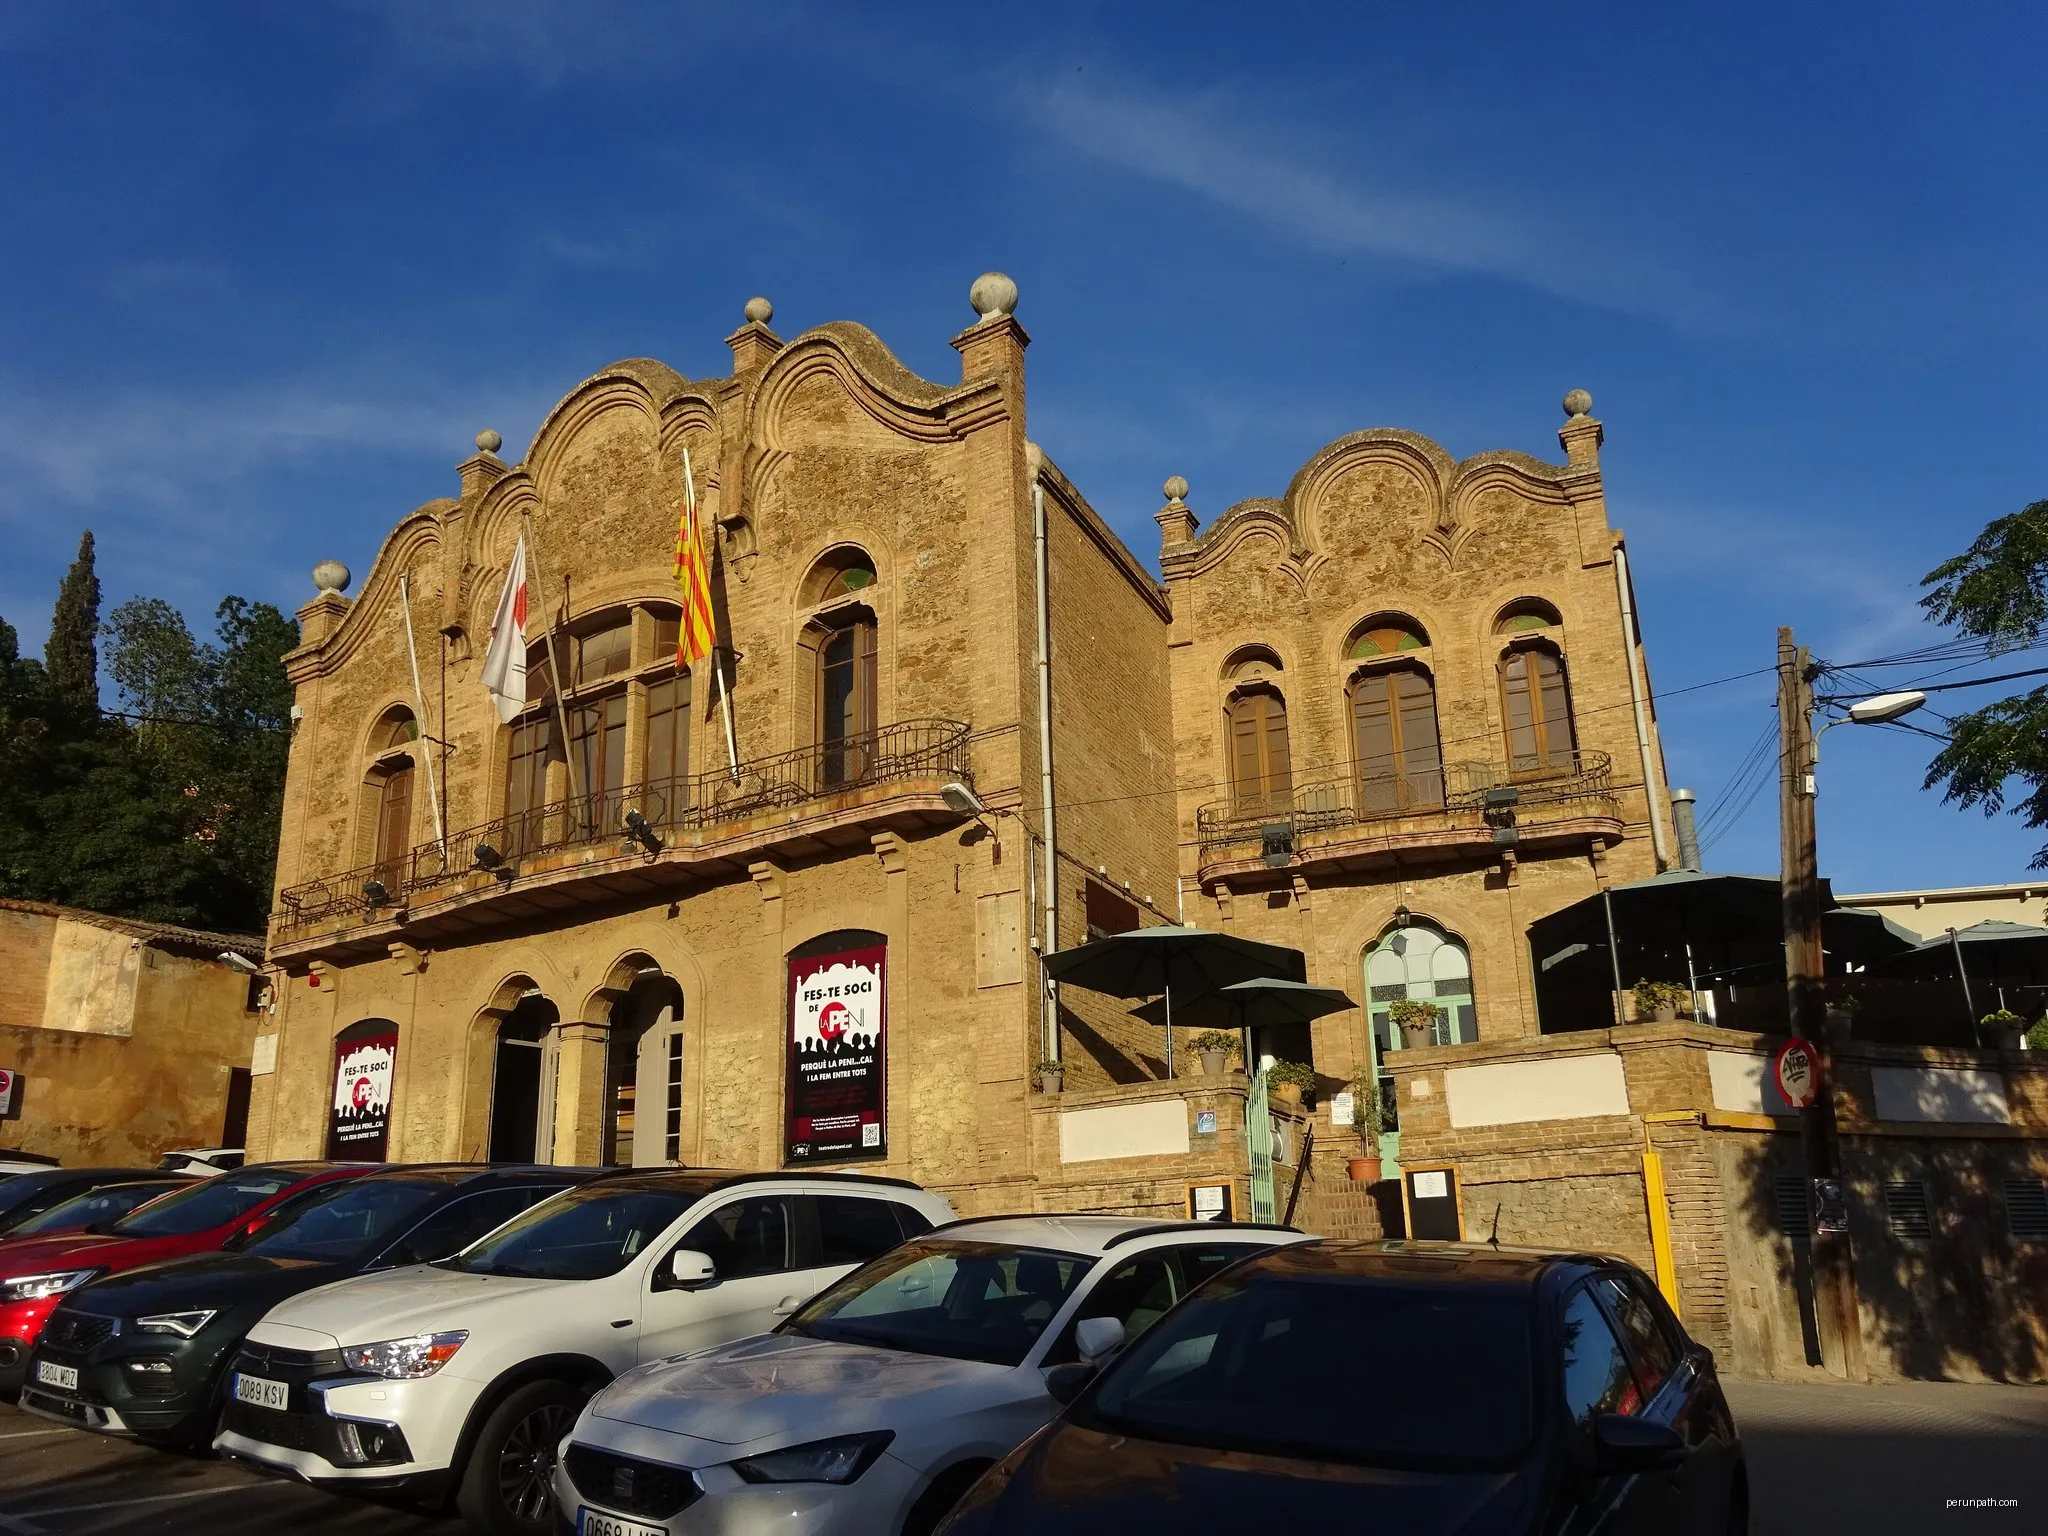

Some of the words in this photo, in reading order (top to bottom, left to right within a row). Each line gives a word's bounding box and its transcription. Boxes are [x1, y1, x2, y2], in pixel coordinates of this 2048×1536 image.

[804, 986, 840, 1001] FES-TE
[844, 981, 872, 996] SOCI
[808, 1004, 819, 1013] DE
[345, 1065, 368, 1076] FES-TE
[370, 1061, 388, 1071] SOCI
[800, 1059, 827, 1071] PERQUÈ
[828, 1060, 837, 1068] LA
[810, 1074, 818, 1082] LA
[820, 1072, 832, 1080] FEM
[832, 1070, 851, 1079] ENTRE
[852, 1068, 867, 1076] TOTS
[240, 1378, 262, 1401] 0089
[264, 1383, 285, 1406] KSV
